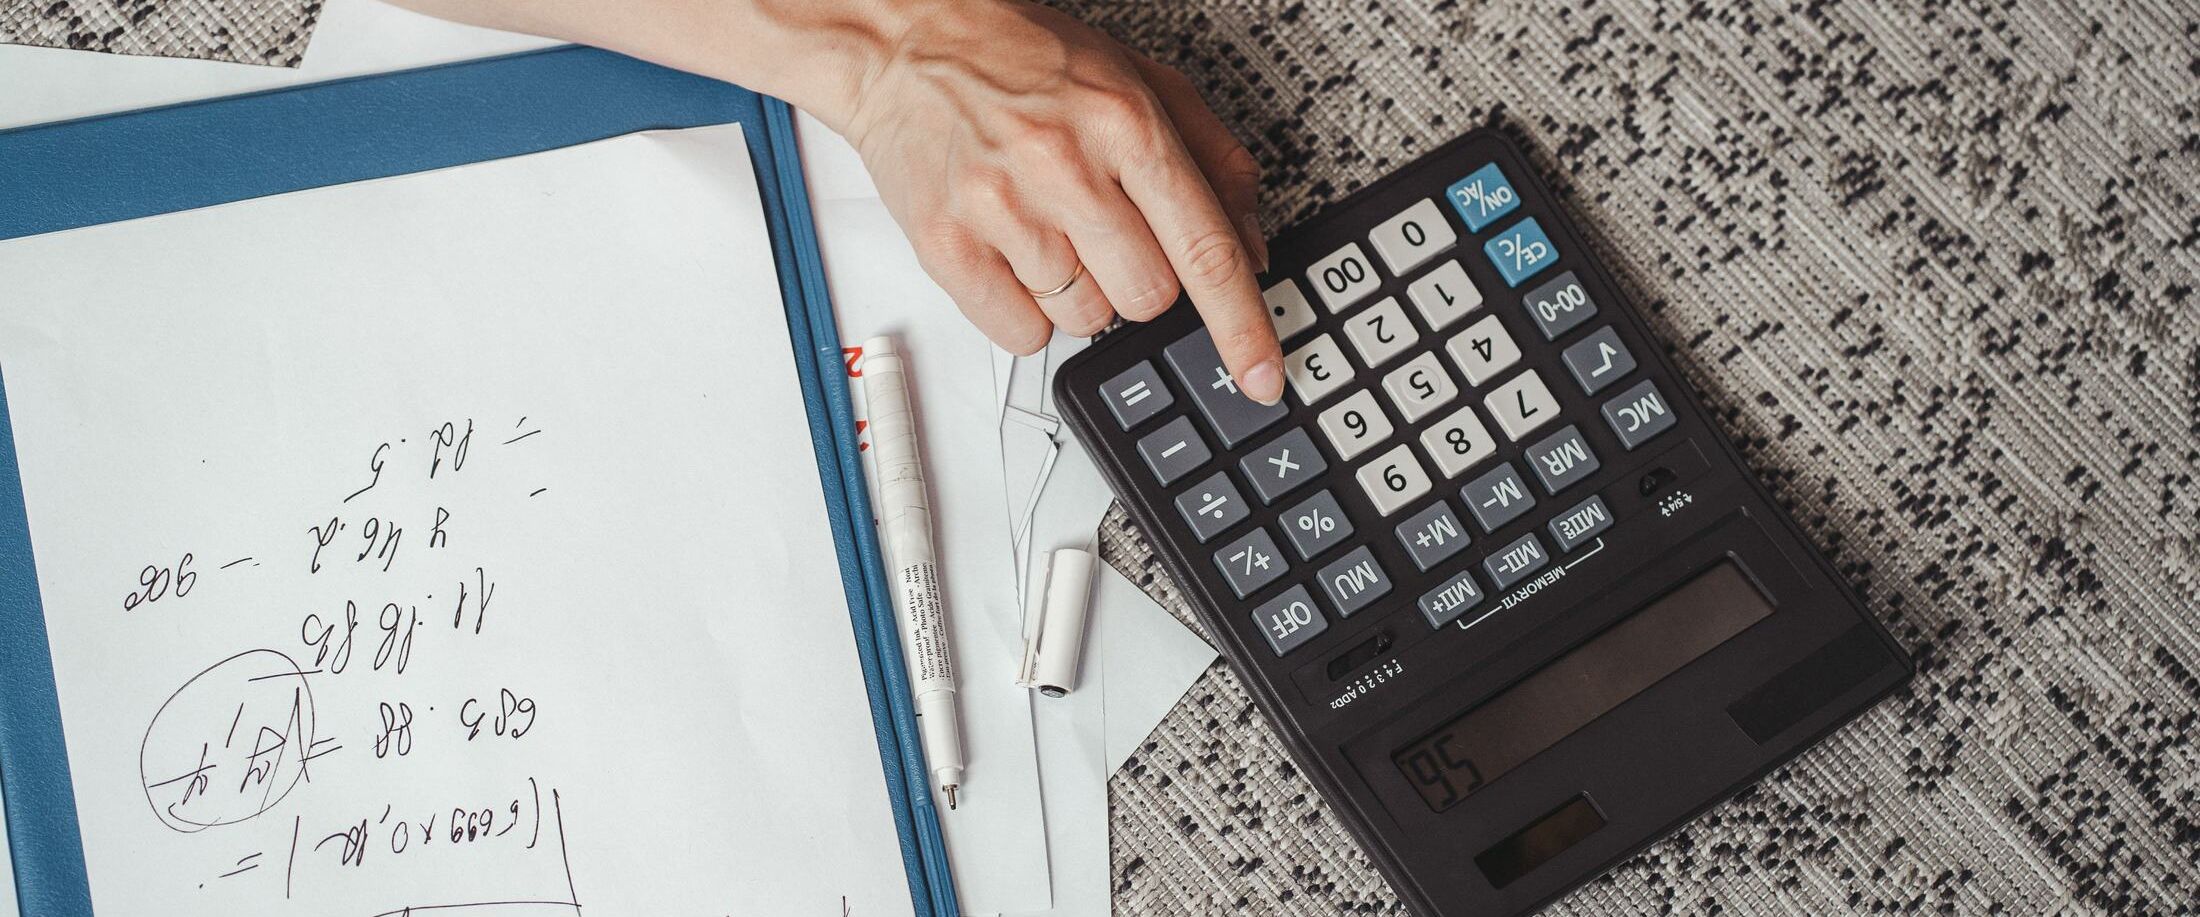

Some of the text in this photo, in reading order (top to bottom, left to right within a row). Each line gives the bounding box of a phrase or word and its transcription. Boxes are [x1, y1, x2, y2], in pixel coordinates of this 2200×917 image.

[1401, 220, 1426, 247] 0
[1322, 256, 1365, 294] 00
[1434, 283, 1455, 307] 1
[1366, 314, 1395, 344] 2
[1471, 337, 1492, 363] 4
[1304, 353, 1331, 382] 3
[1409, 369, 1435, 400] 5
[1516, 389, 1539, 419] 7
[1617, 392, 1665, 432] MC
[1343, 410, 1368, 439] 6
[1445, 427, 1472, 455] 8
[1540, 438, 1588, 476] MR
[1383, 464, 1407, 492] 9
[1298, 508, 1335, 539] %
[1416, 514, 1458, 548] M+
[1334, 560, 1379, 600] MU
[1271, 601, 1312, 640] OFF
[1376, 674, 1385, 683] 3
[1385, 669, 1393, 678] 4
[1395, 663, 1403, 674] F
[1358, 684, 1367, 694] 0
[1366, 678, 1376, 689] 2
